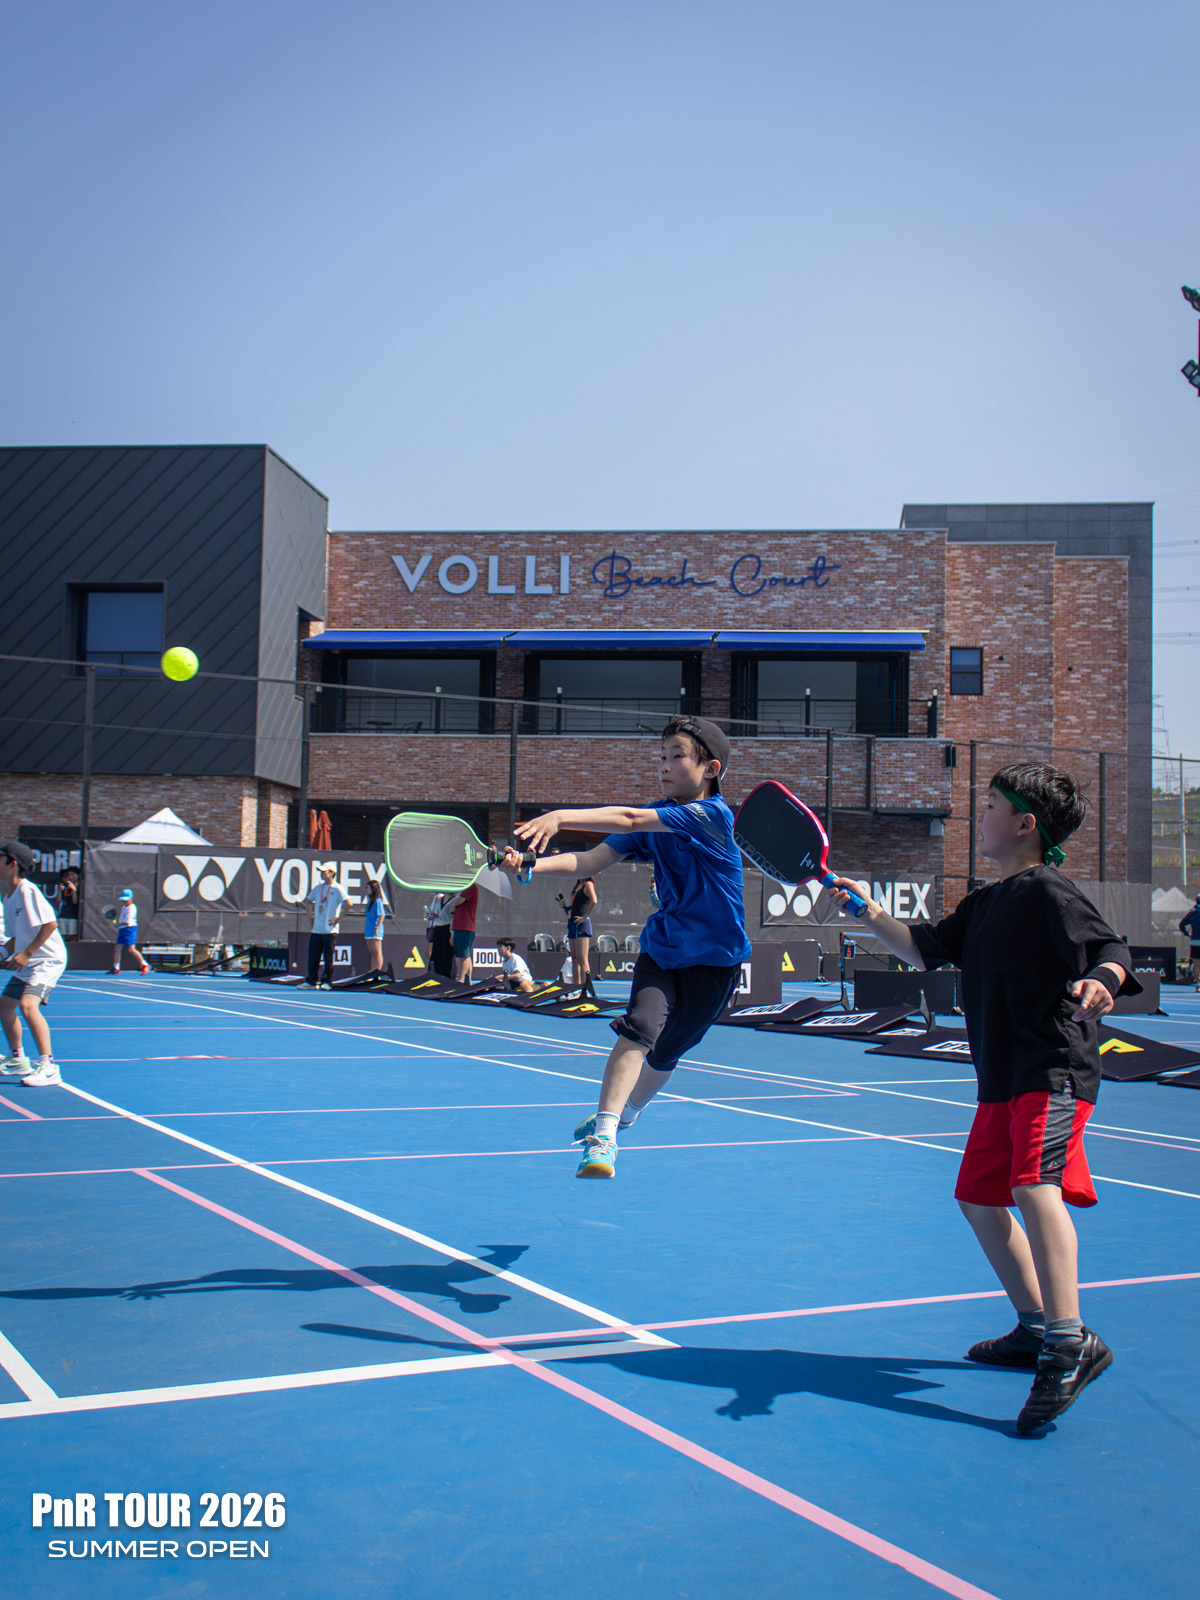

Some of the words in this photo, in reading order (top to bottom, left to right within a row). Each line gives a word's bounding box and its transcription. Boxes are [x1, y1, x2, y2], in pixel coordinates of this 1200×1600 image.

[392, 554, 570, 595] VOLLI
[592, 550, 717, 598] Beach
[731, 553, 841, 598] Court
[837, 880, 931, 919] NEX
